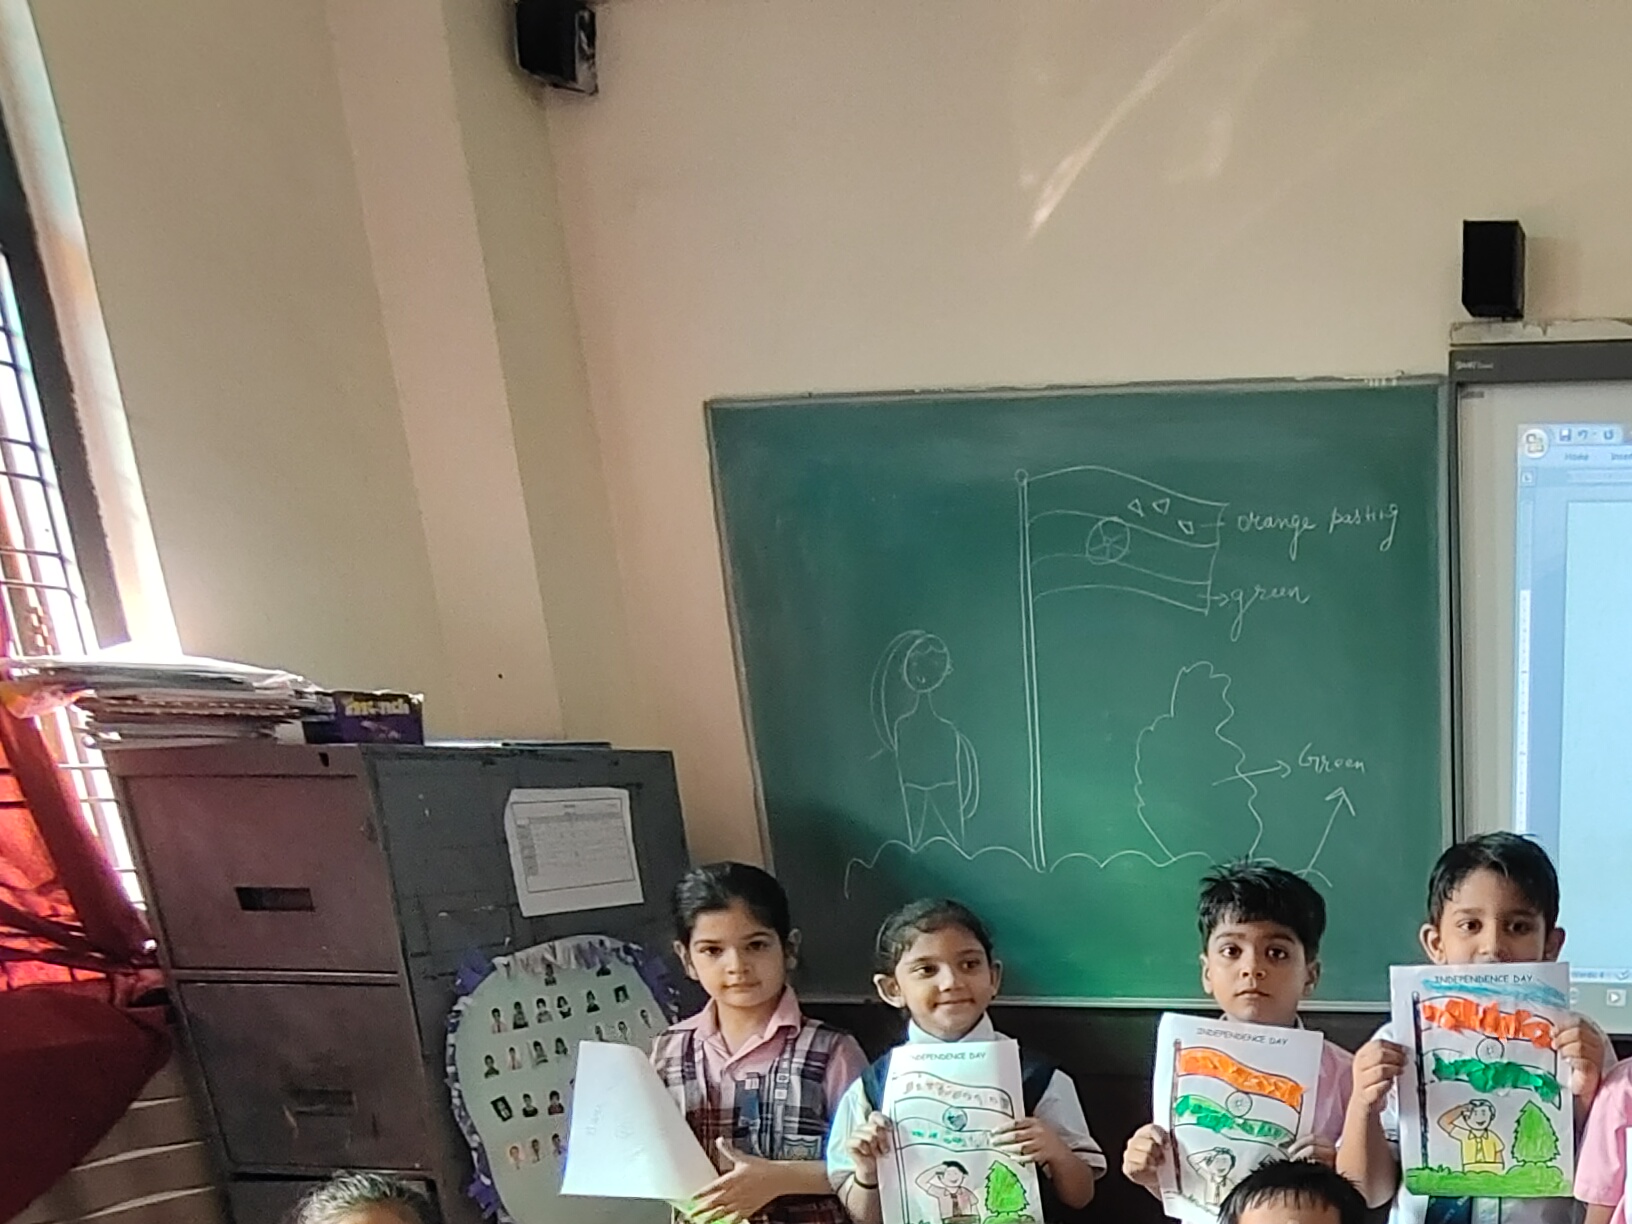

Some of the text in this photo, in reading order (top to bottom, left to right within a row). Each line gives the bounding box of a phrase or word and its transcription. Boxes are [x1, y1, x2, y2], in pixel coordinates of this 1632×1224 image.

[1237, 512, 1316, 561] orange
[1230, 584, 1311, 642] green
[1434, 974, 1533, 984] INDEPENDENCE DAY
[1196, 1028, 1289, 1046] INDEPENDENCE DAY
[969, 1052, 986, 1060] DAY
